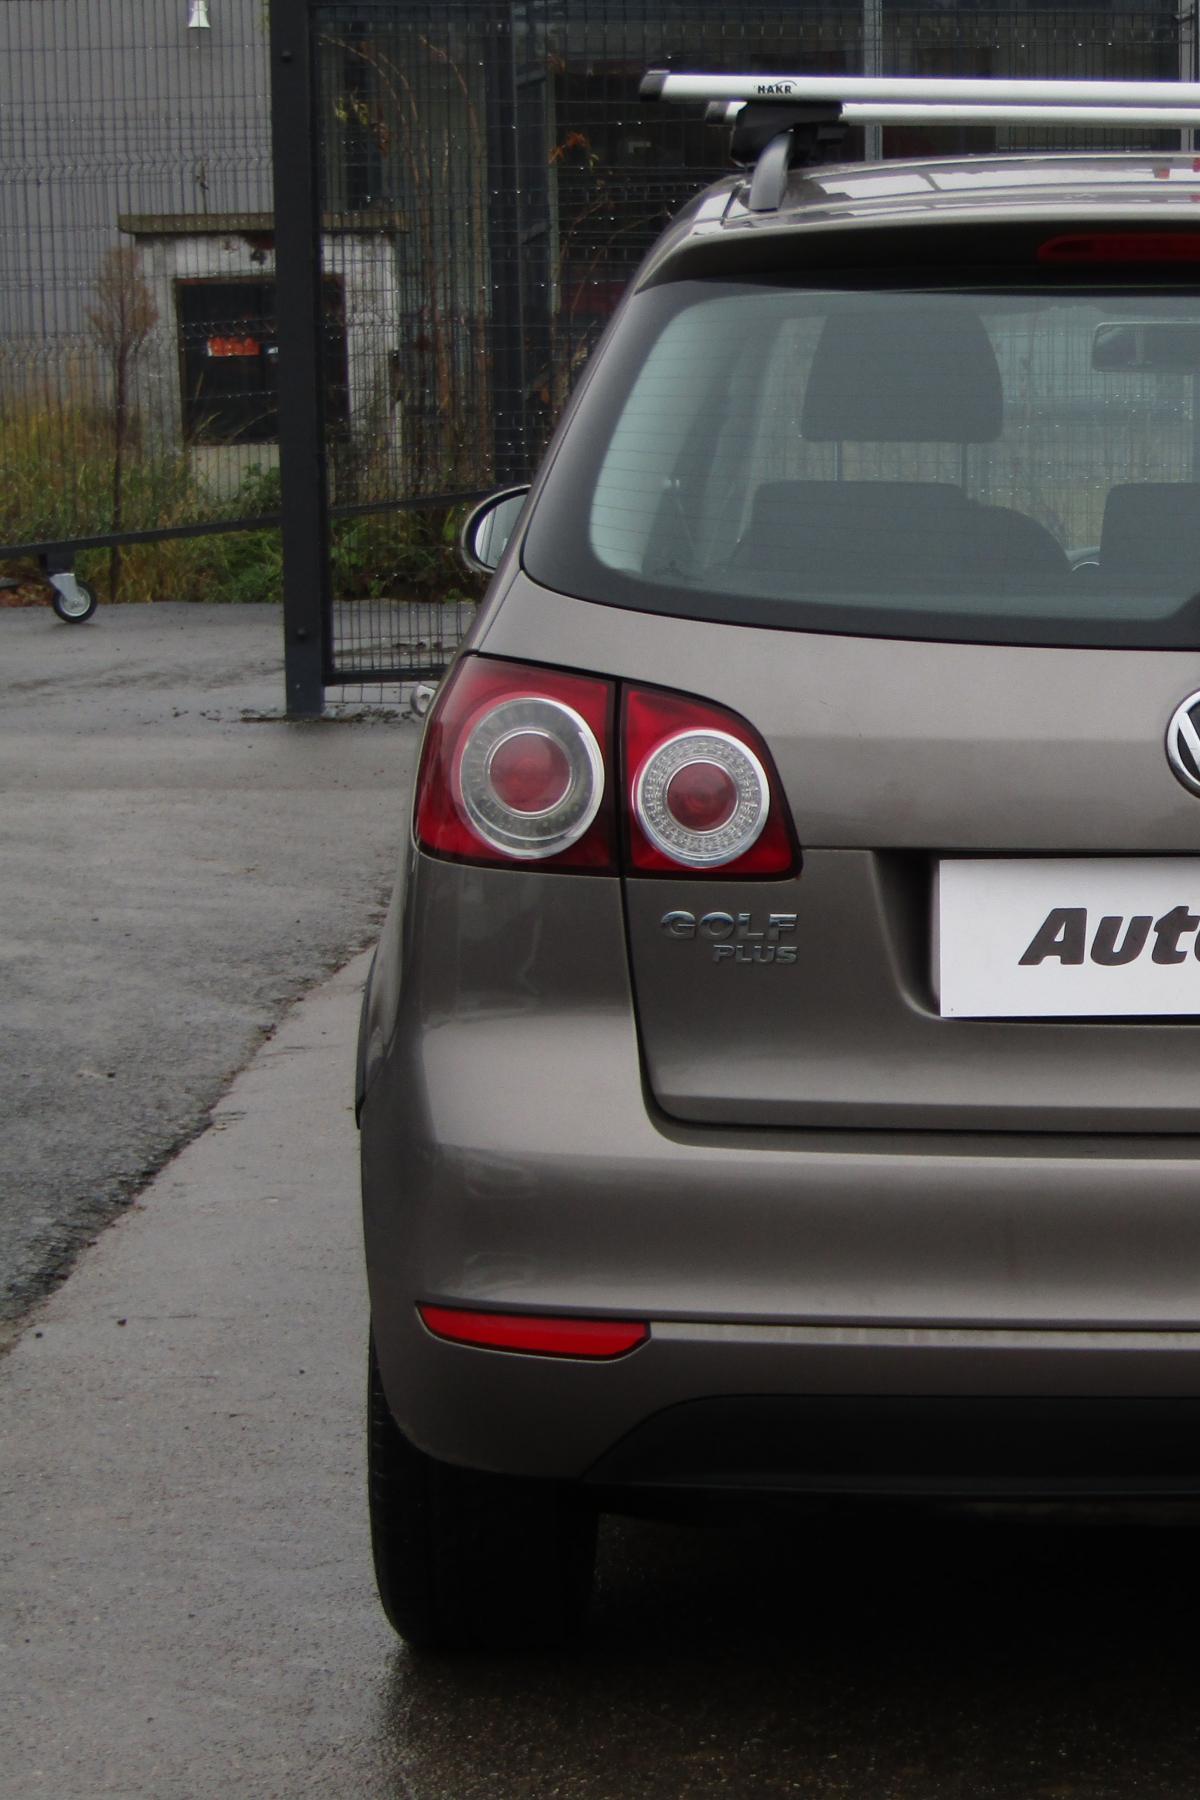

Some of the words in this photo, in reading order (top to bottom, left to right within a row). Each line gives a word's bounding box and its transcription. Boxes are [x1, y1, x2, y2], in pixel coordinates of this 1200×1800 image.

[757, 85, 793, 94] HAKR
[660, 910, 798, 941] GOLF
[712, 944, 798, 963] PLUS
